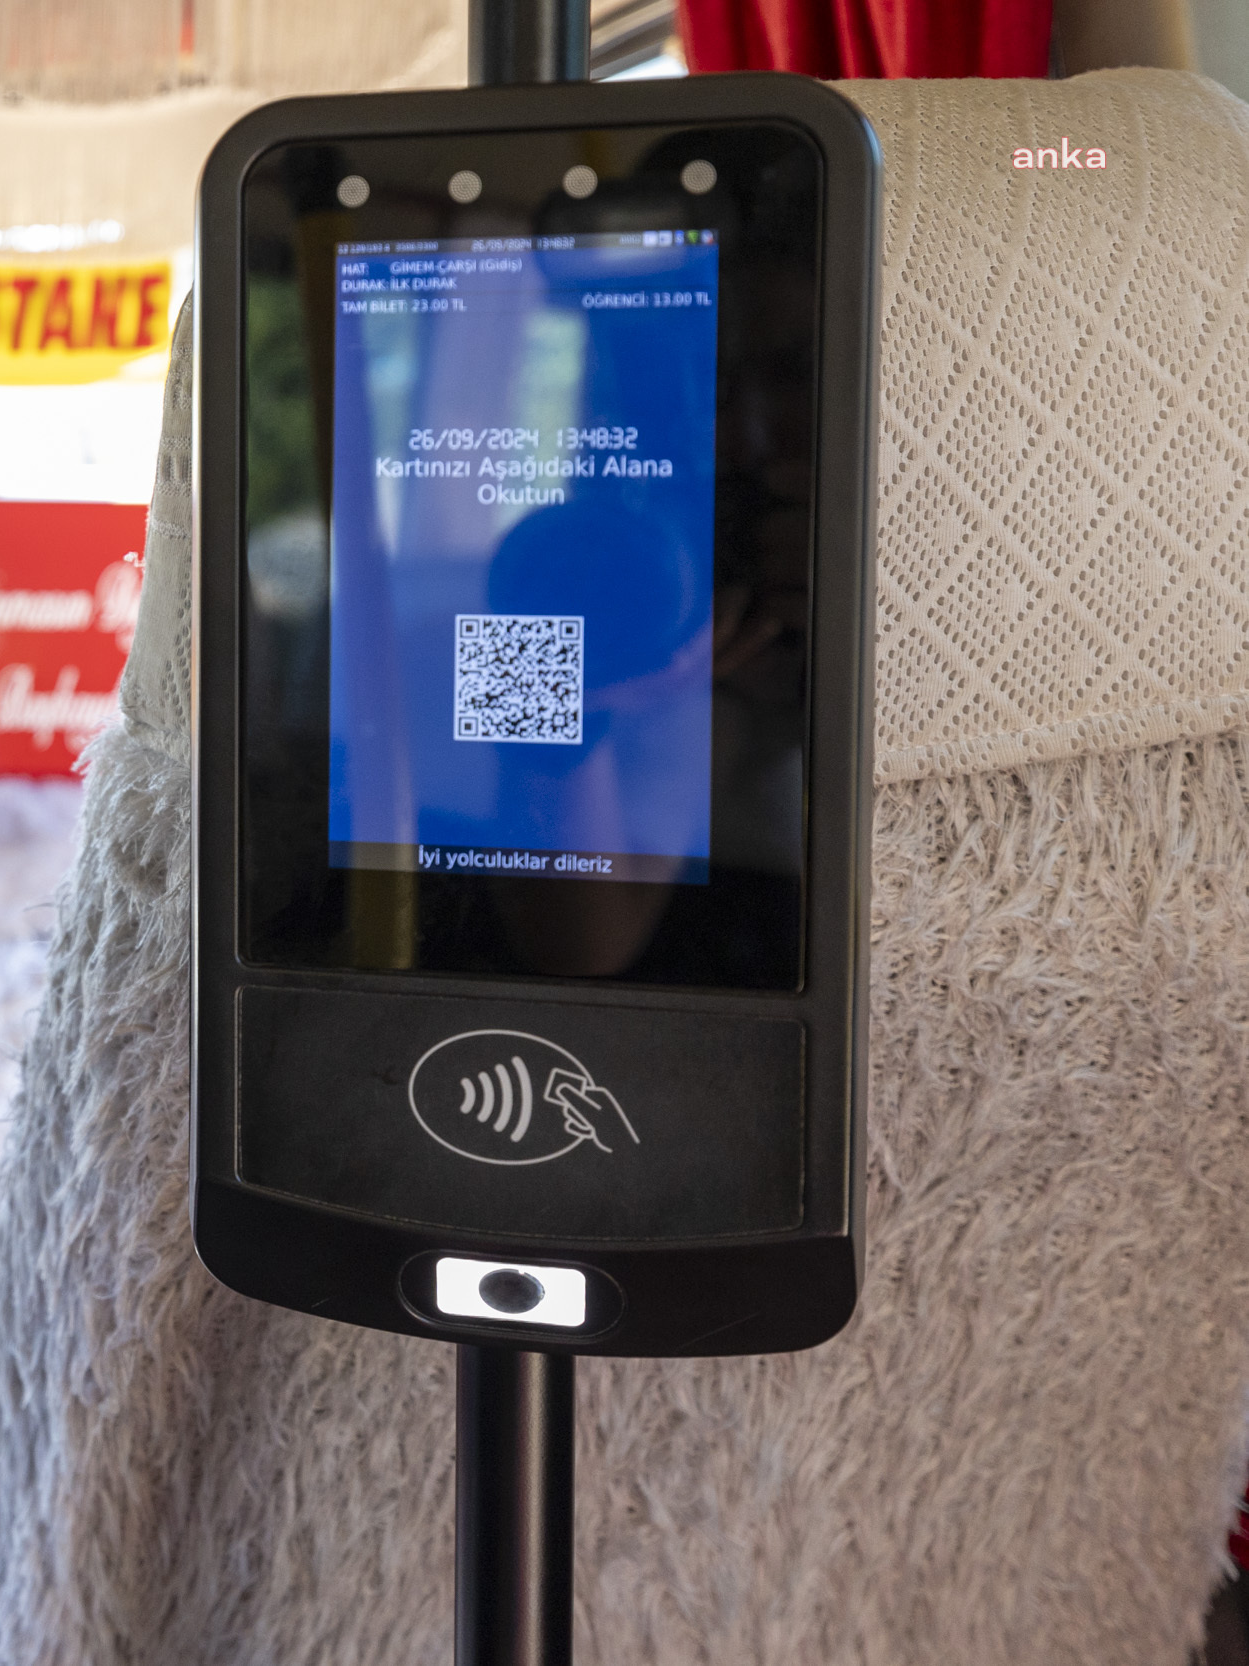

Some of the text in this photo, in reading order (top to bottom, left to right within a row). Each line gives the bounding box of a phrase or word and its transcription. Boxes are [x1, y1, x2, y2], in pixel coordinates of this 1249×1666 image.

[341, 262, 369, 276] HAT:
[341, 276, 457, 293] DURAK: İLK DURAK
[342, 300, 367, 314] TAM
[411, 298, 448, 312] 23.00
[452, 298, 467, 312] TL
[653, 291, 692, 307] 13.00
[695, 291, 712, 306] TL
[409, 427, 638, 450] 26/09/2024 13:48:32
[376, 455, 673, 482] Kartınızı Aşağıdaki Alana
[477, 483, 565, 505] Okutun
[418, 844, 613, 874] İyi yolculuklar dileriz
